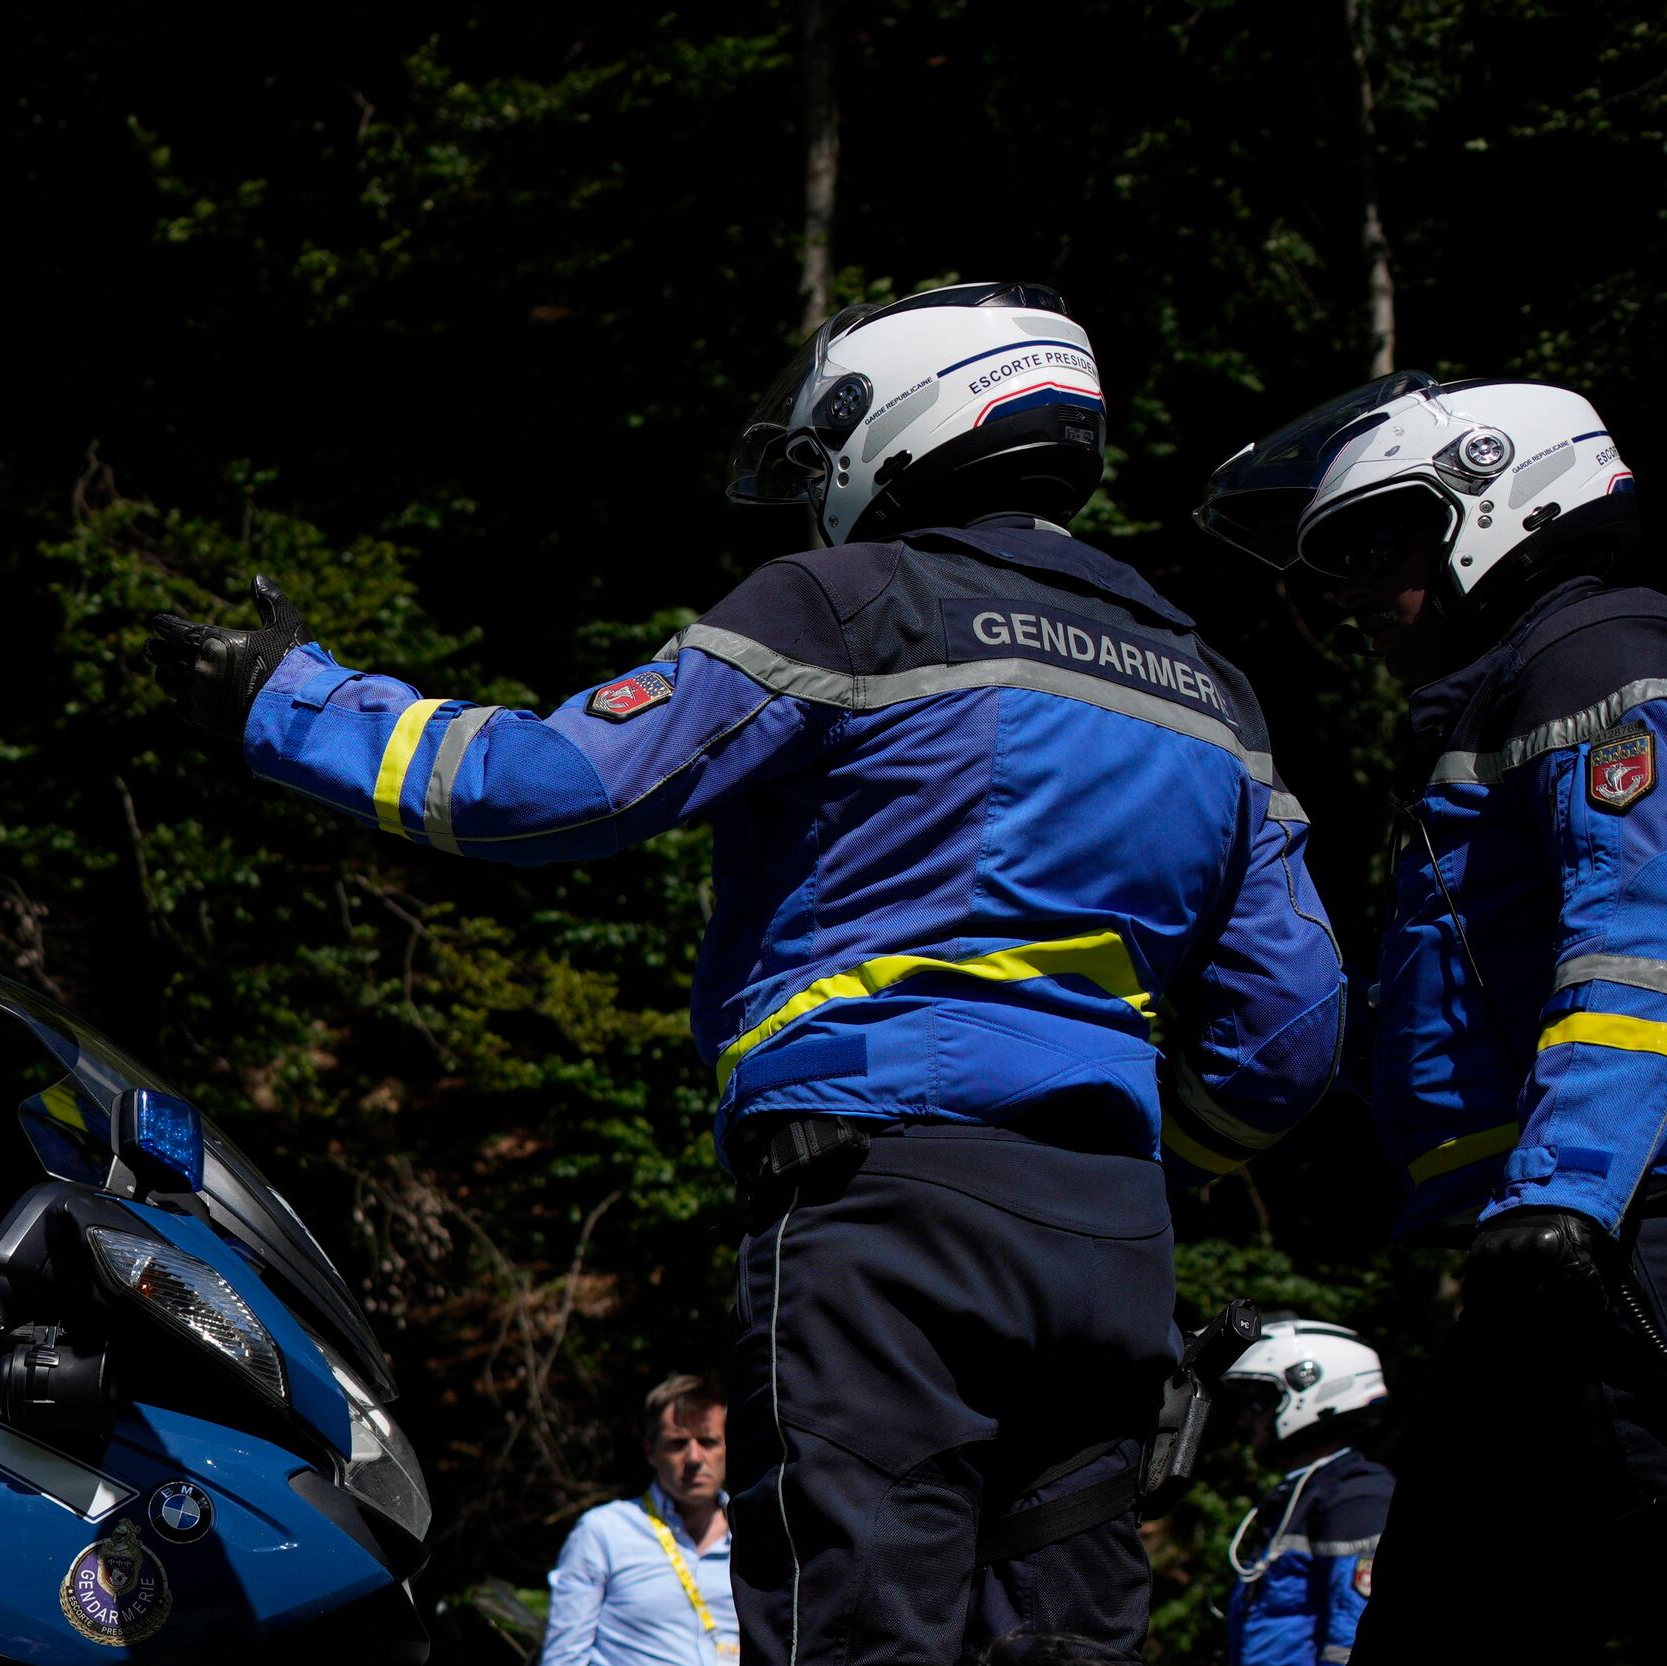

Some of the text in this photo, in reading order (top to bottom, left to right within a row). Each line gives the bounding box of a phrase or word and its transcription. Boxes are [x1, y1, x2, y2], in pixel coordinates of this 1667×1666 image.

[969, 353, 1043, 395] ESCORTE
[864, 377, 934, 426] GARDE REPUBLICAINE
[1512, 440, 1570, 474] GARDE REPUBLICAINE
[160, 1484, 210, 1512] BMW
[68, 1596, 95, 1628] ESCORTE
[78, 1569, 155, 1624] GENDARMERIE
